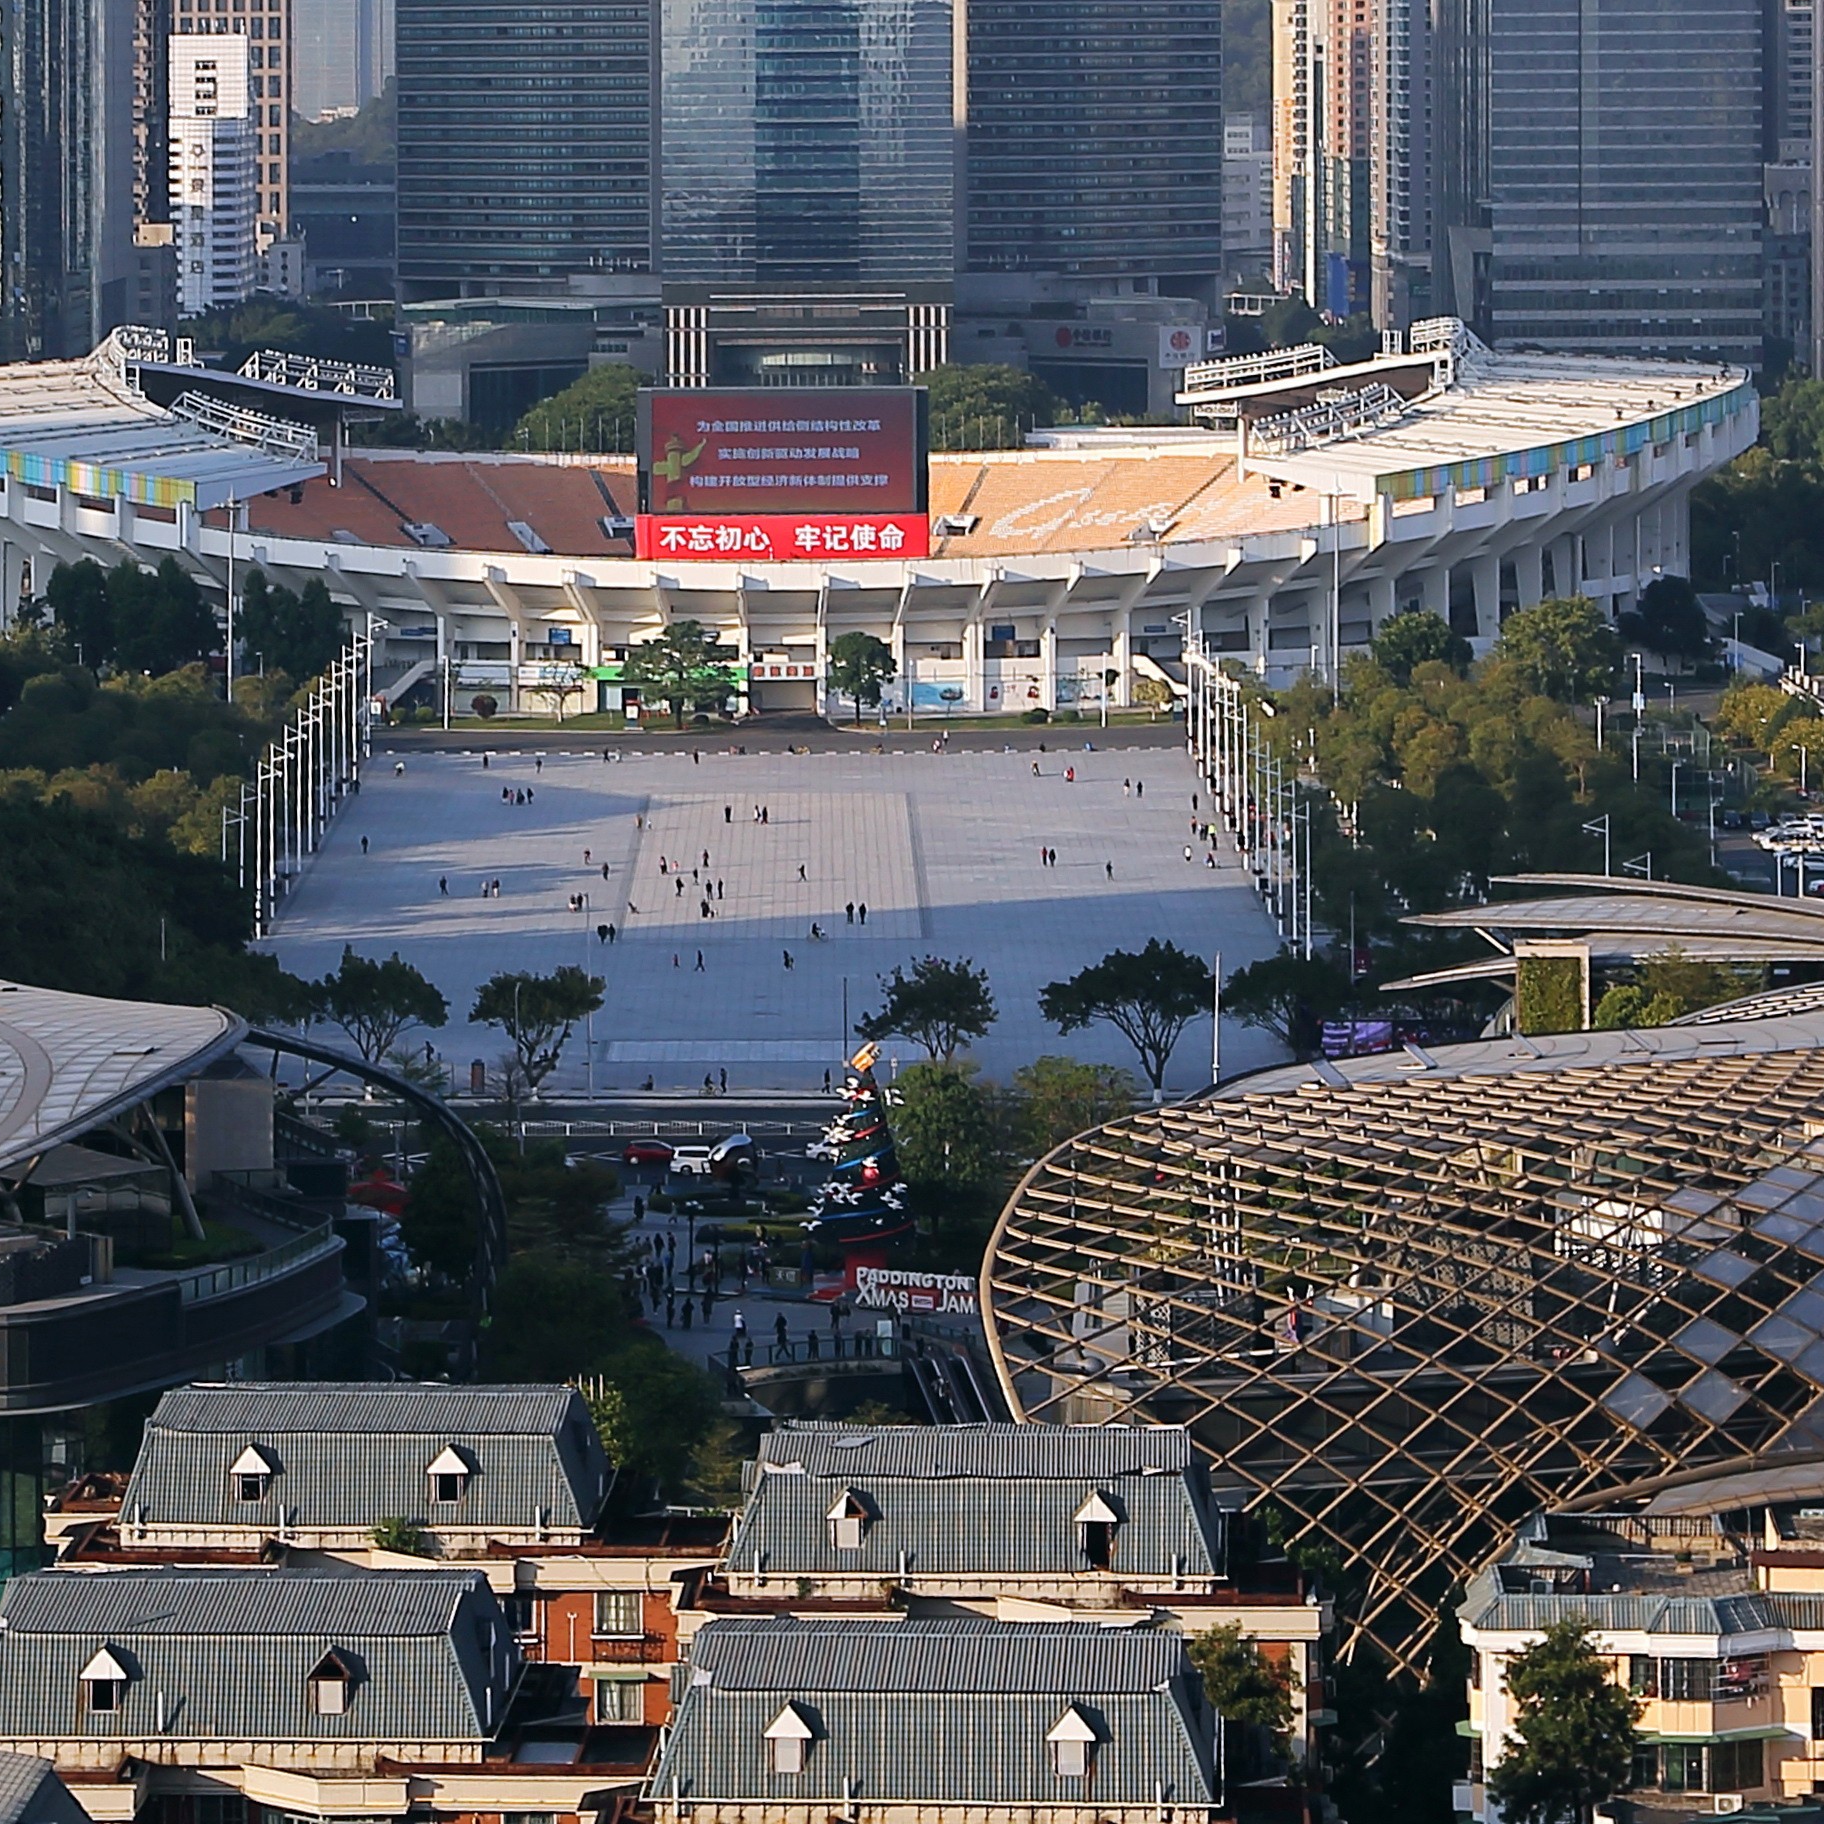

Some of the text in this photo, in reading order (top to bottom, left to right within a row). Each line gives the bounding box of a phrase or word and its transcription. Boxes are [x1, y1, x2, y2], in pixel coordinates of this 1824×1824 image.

[659, 523, 905, 552] 不忘初心 牢记使命
[855, 1266, 975, 1291] PADDINGTON
[936, 1288, 975, 1314] JAM
